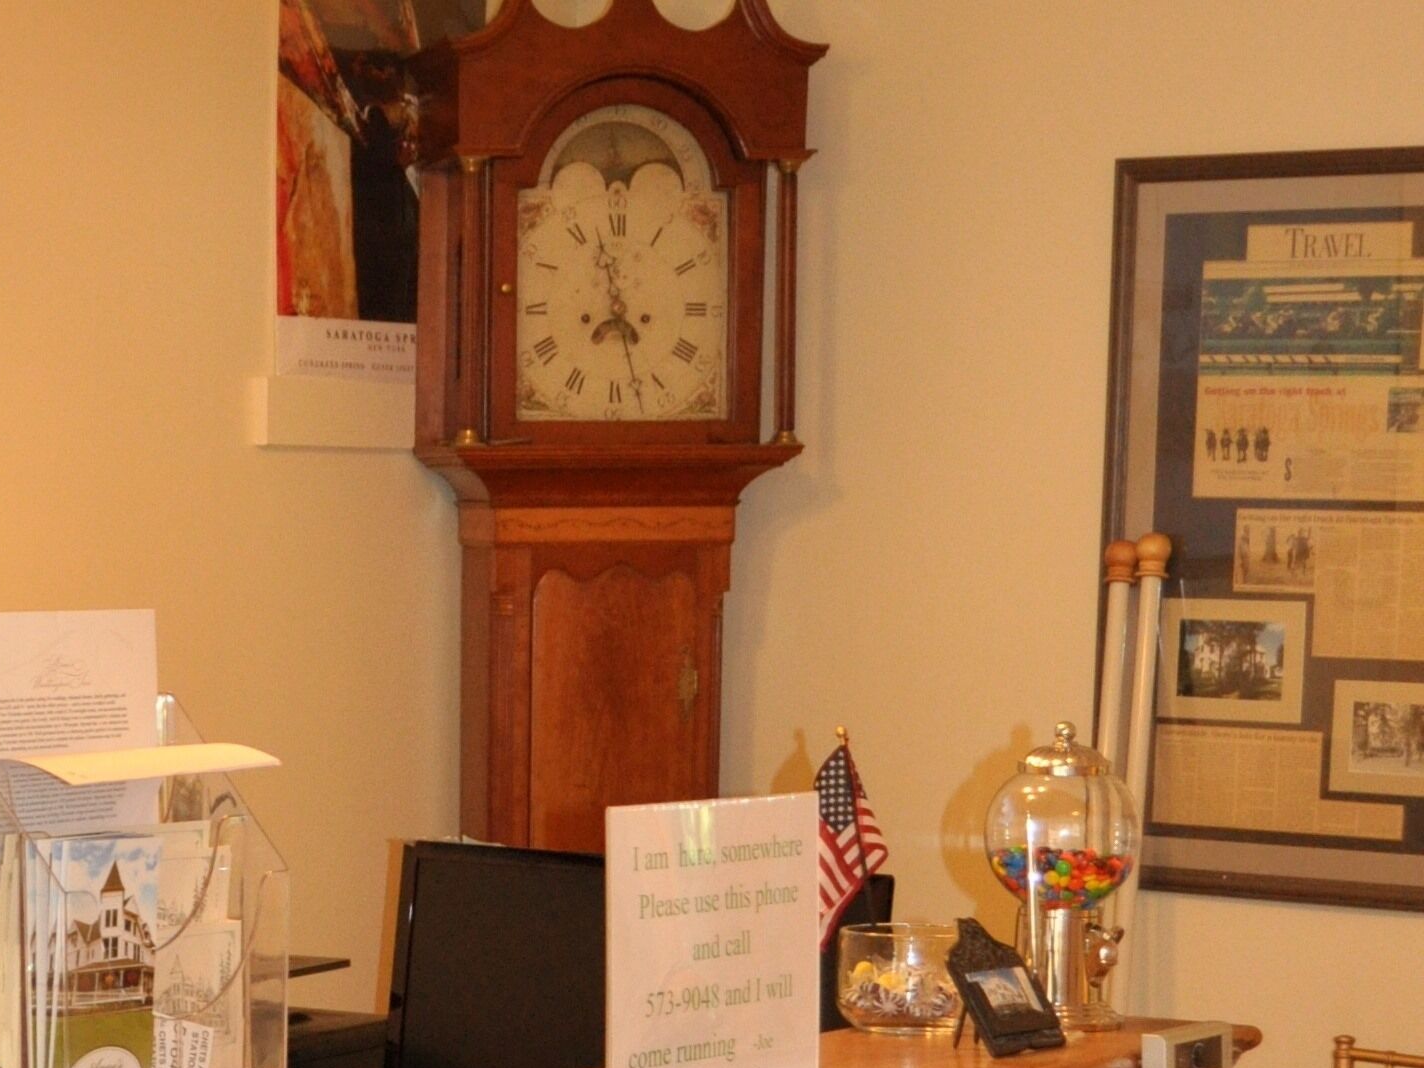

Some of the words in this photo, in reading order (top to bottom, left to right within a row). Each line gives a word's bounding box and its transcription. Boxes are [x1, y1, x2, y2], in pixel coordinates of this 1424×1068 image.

[326, 328, 390, 343] SARATOGA
[632, 846, 641, 872] I
[645, 851, 669, 871] am
[720, 834, 803, 864] somewhere
[639, 893, 690, 920] Please
[694, 893, 720, 913] use
[725, 884, 751, 910] this
[755, 881, 799, 914] phone
[692, 934, 720, 961] and
[725, 930, 751, 957] call
[645, 983, 720, 1018] 573-9048
[725, 979, 751, 1007] and
[755, 978, 761, 1001] I
[766, 974, 793, 999] will
[158, 1031, 167, 1065] CHETS
[676, 1032, 736, 1062] running
